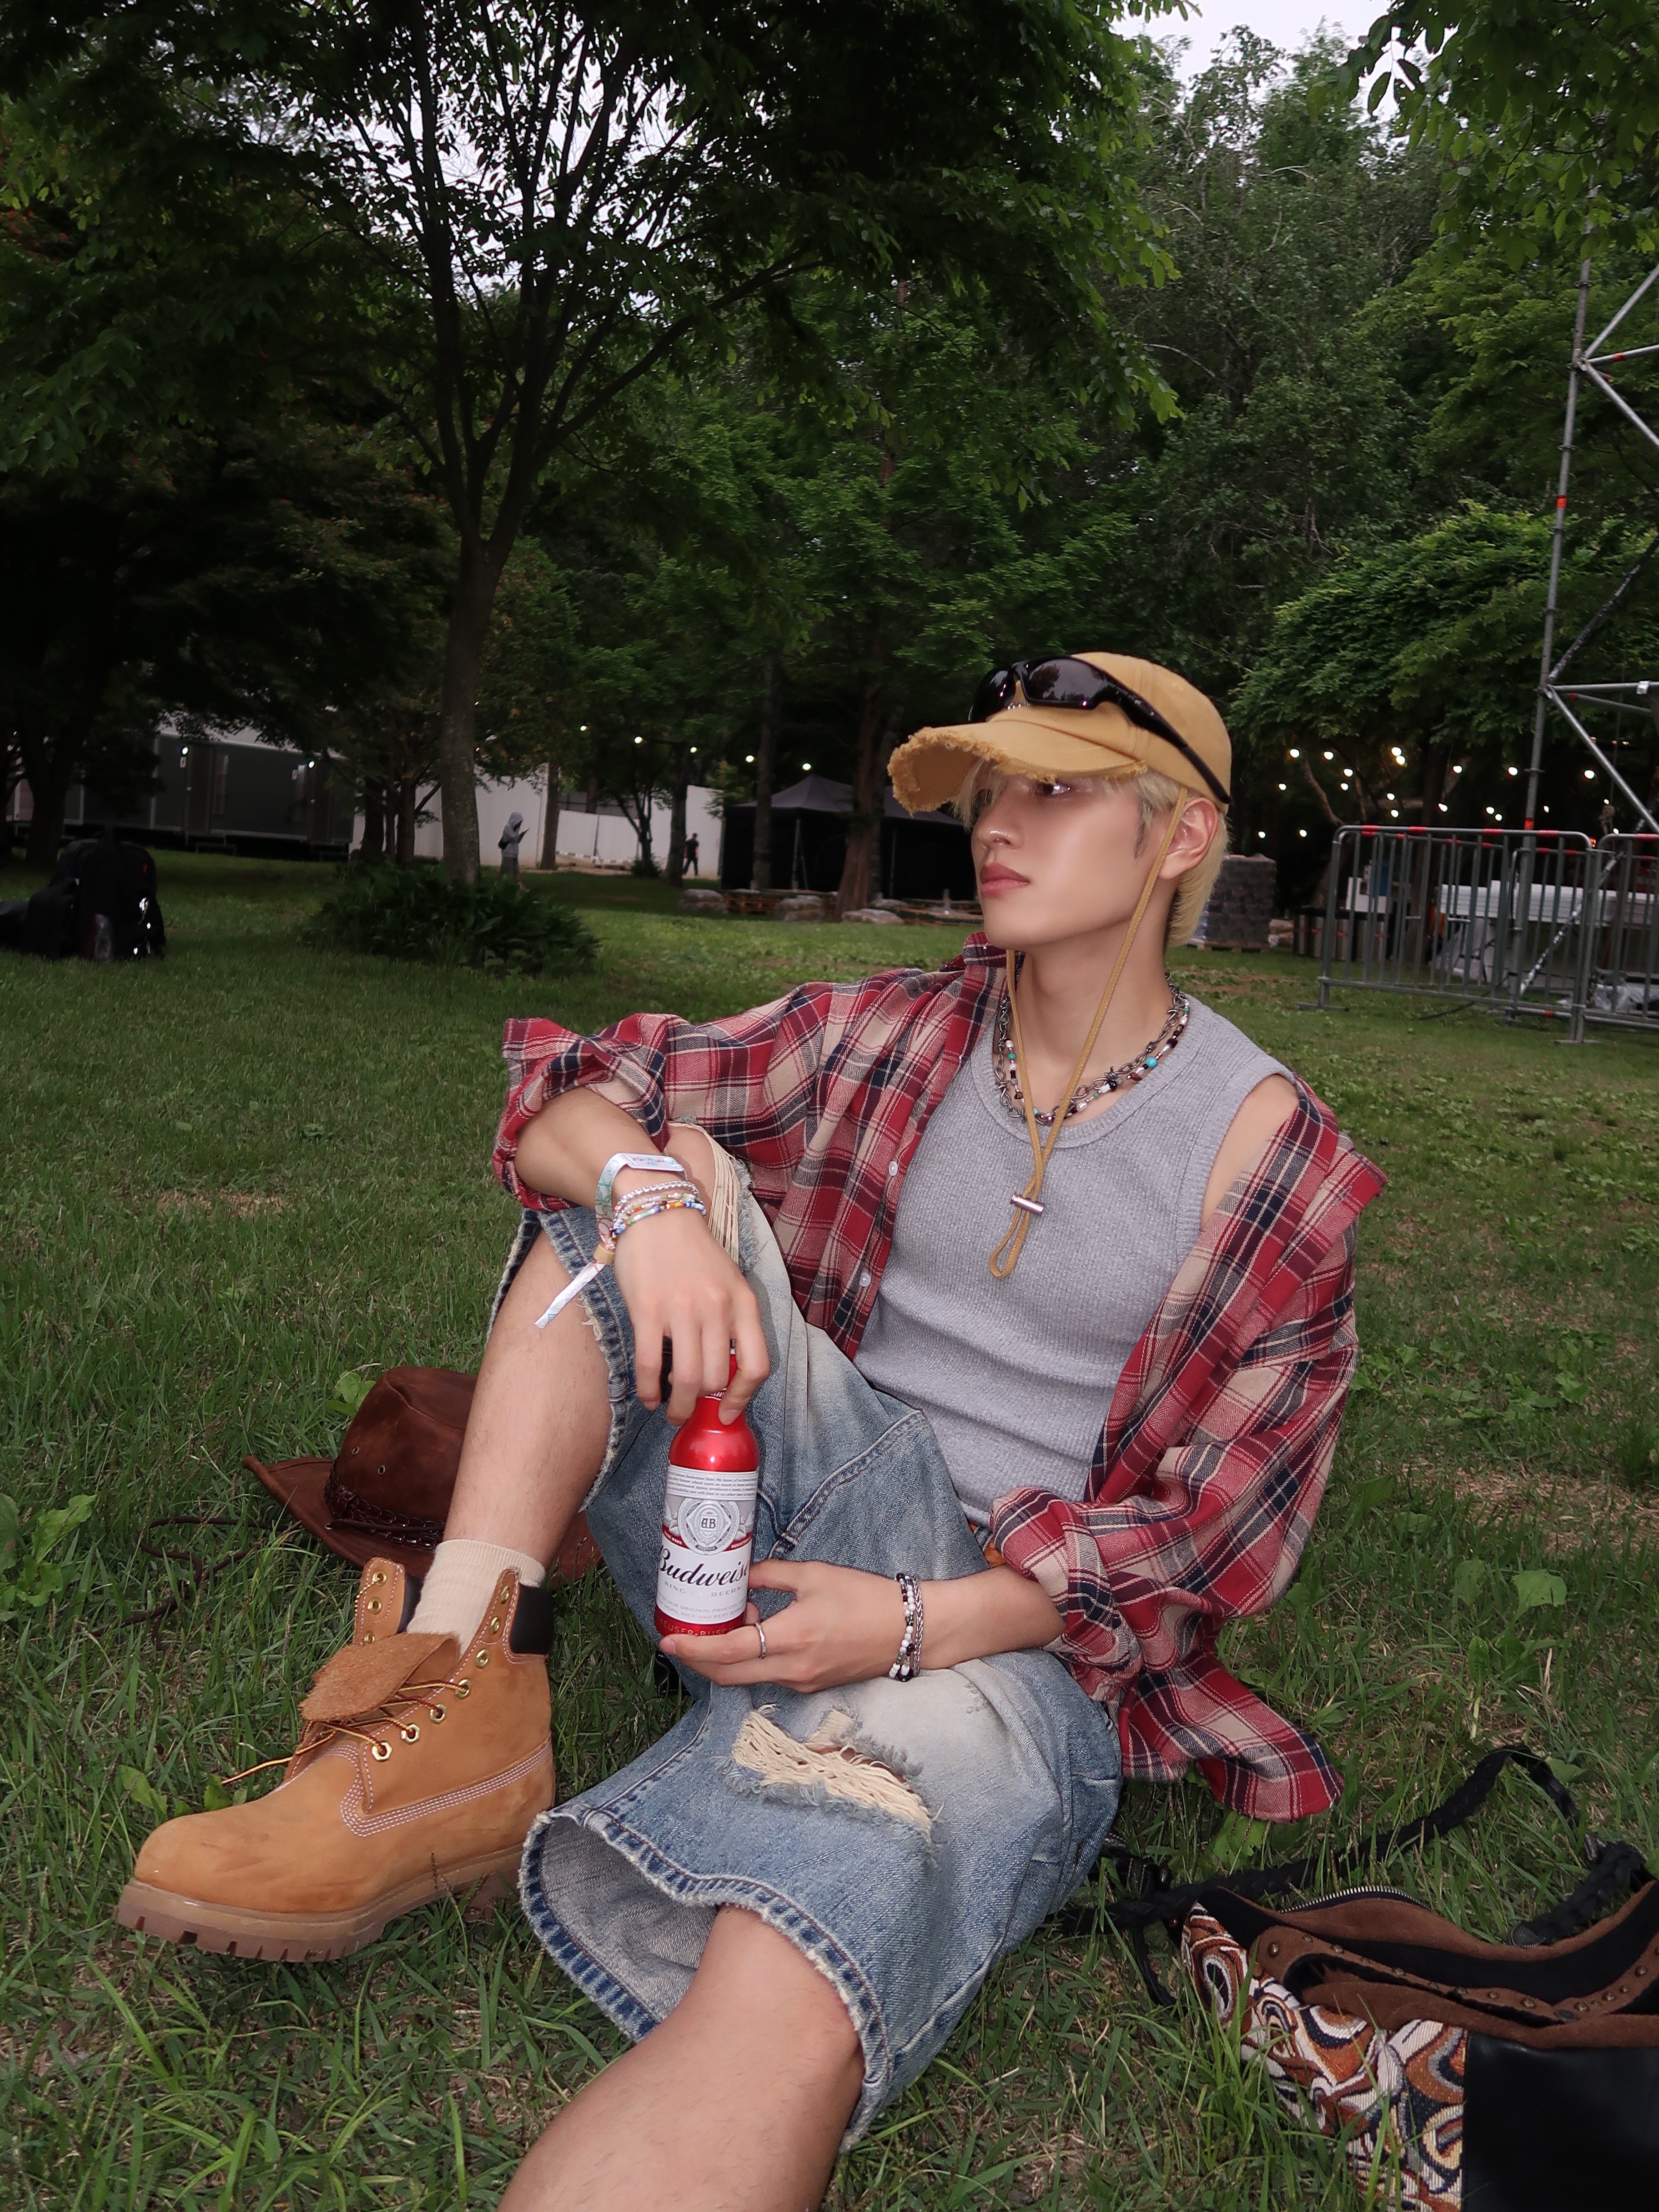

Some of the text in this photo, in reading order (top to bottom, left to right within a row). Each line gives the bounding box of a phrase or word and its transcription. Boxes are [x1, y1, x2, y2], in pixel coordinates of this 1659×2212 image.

[701, 1518, 716, 1529] AB
[664, 1580, 685, 1594] KING
[711, 1585, 741, 1597] BEERS
